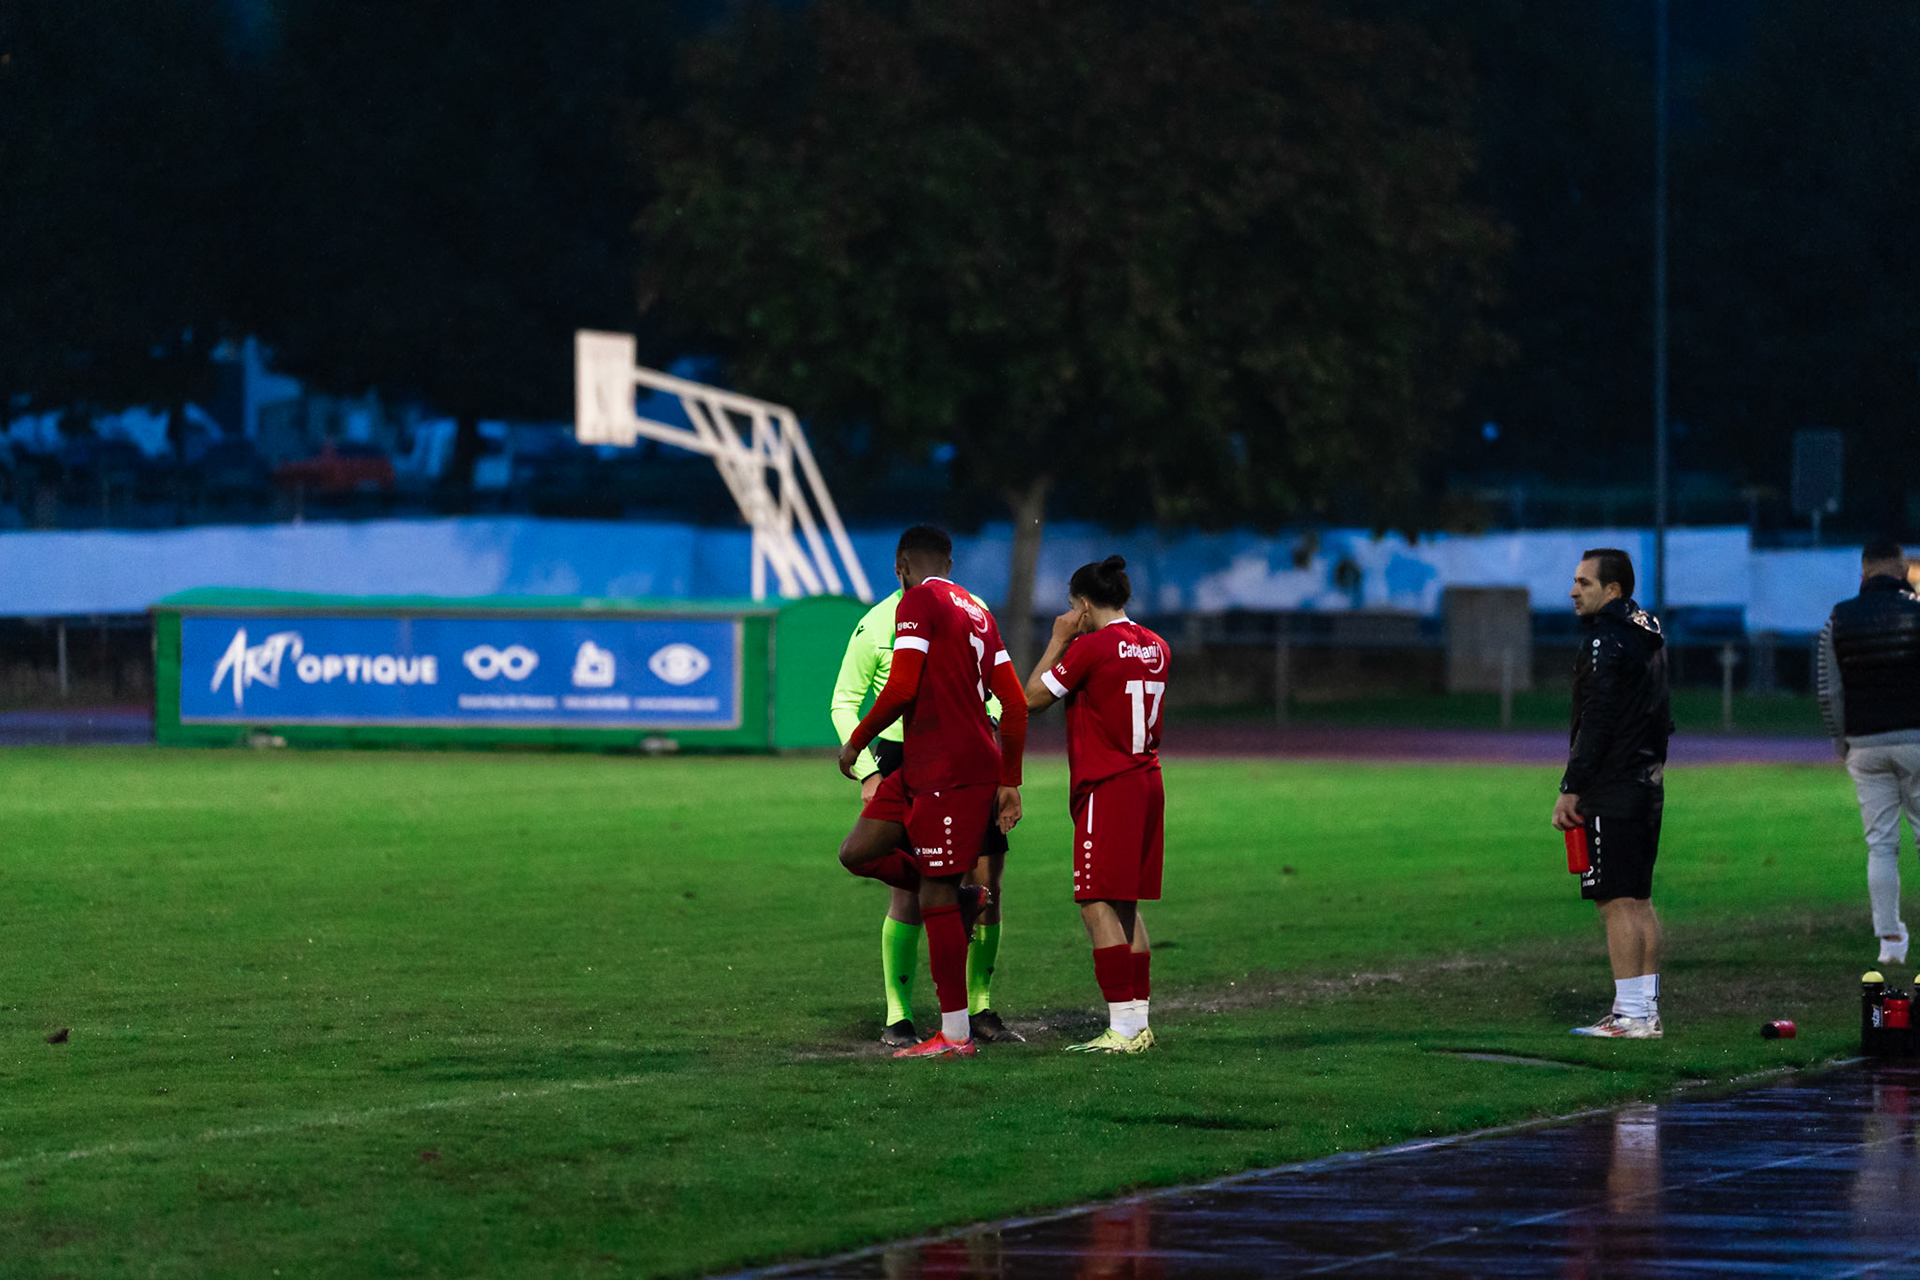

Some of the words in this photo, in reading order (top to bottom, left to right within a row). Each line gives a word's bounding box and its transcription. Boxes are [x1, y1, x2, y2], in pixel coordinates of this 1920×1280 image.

[902, 621, 918, 630] BCV
[297, 654, 438, 685] OPTIQUE
[1125, 680, 1166, 755] 17
